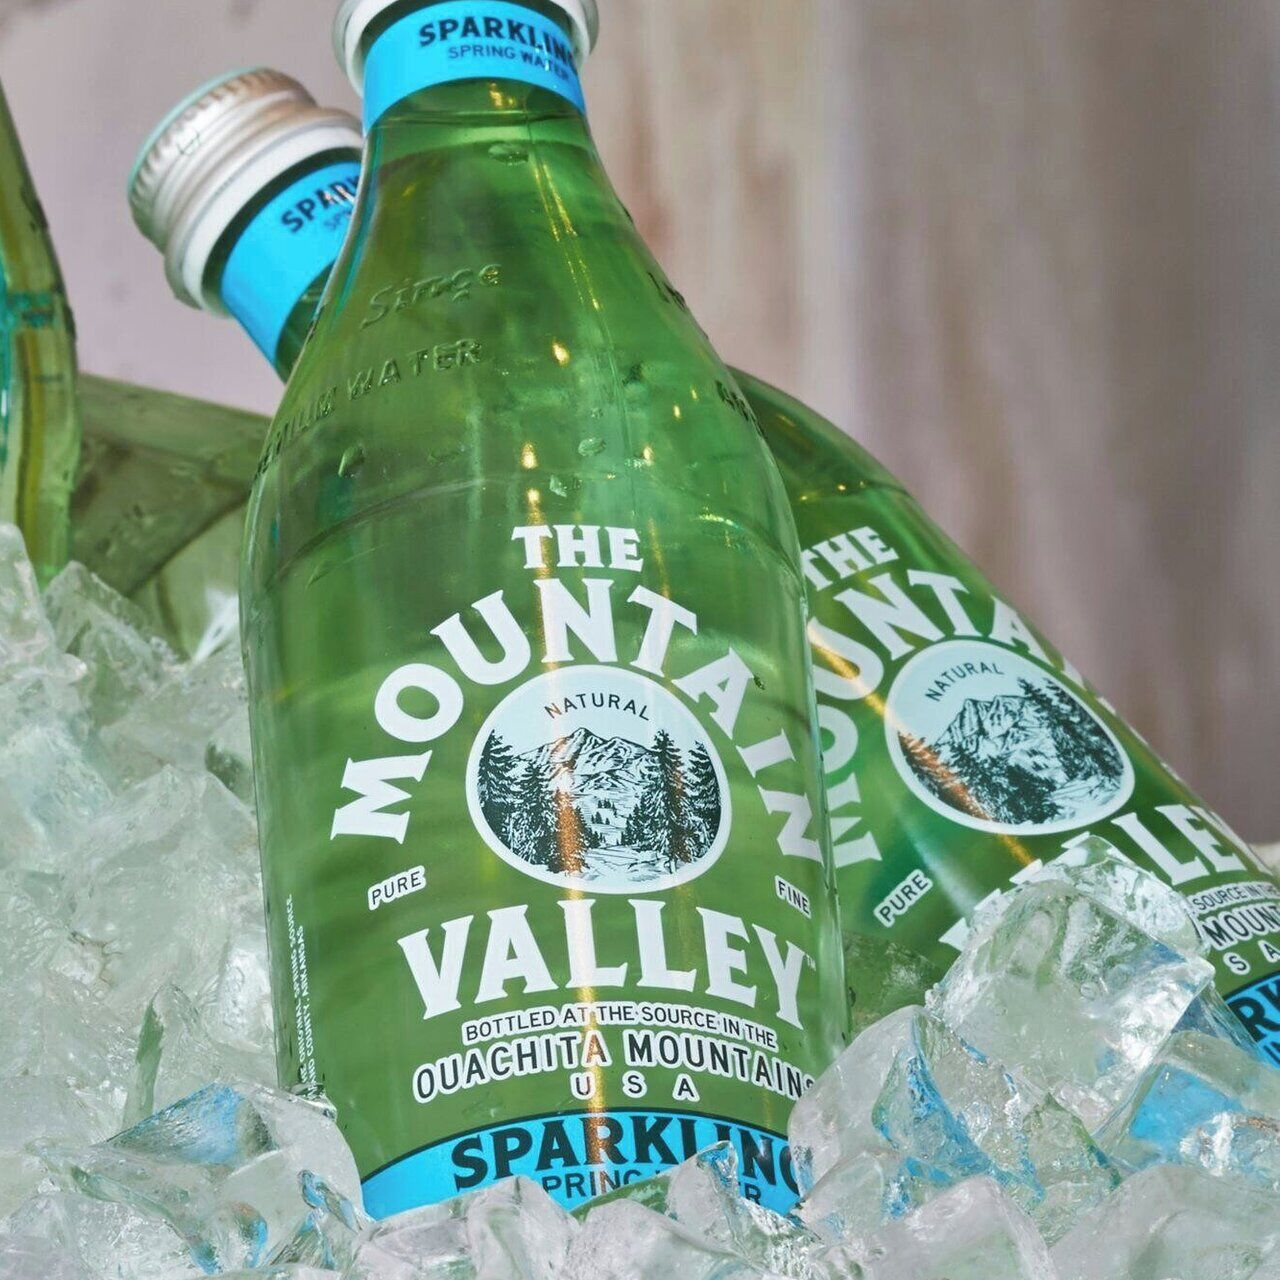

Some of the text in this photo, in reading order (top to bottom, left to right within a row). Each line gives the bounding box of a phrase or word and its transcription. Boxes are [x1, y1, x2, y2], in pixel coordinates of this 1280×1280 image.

[448, 43, 516, 61] SPRING
[511, 524, 644, 574] THE
[801, 526, 899, 591] THE
[924, 660, 1005, 702] NATURAL
[330, 578, 824, 865] MOUNTAIN
[544, 692, 651, 722] NATURAL
[371, 871, 423, 906] PURE
[776, 879, 810, 915] FINE
[879, 873, 929, 923] PURE
[1192, 885, 1247, 912] SOURCE
[396, 898, 807, 1031] VALLEY
[1228, 954, 1248, 972] S
[466, 1005, 776, 1048] BOTTLED AT THE SOURCE IN THE
[416, 1034, 608, 1098] OUACHITA
[575, 1075, 696, 1098] U S A
